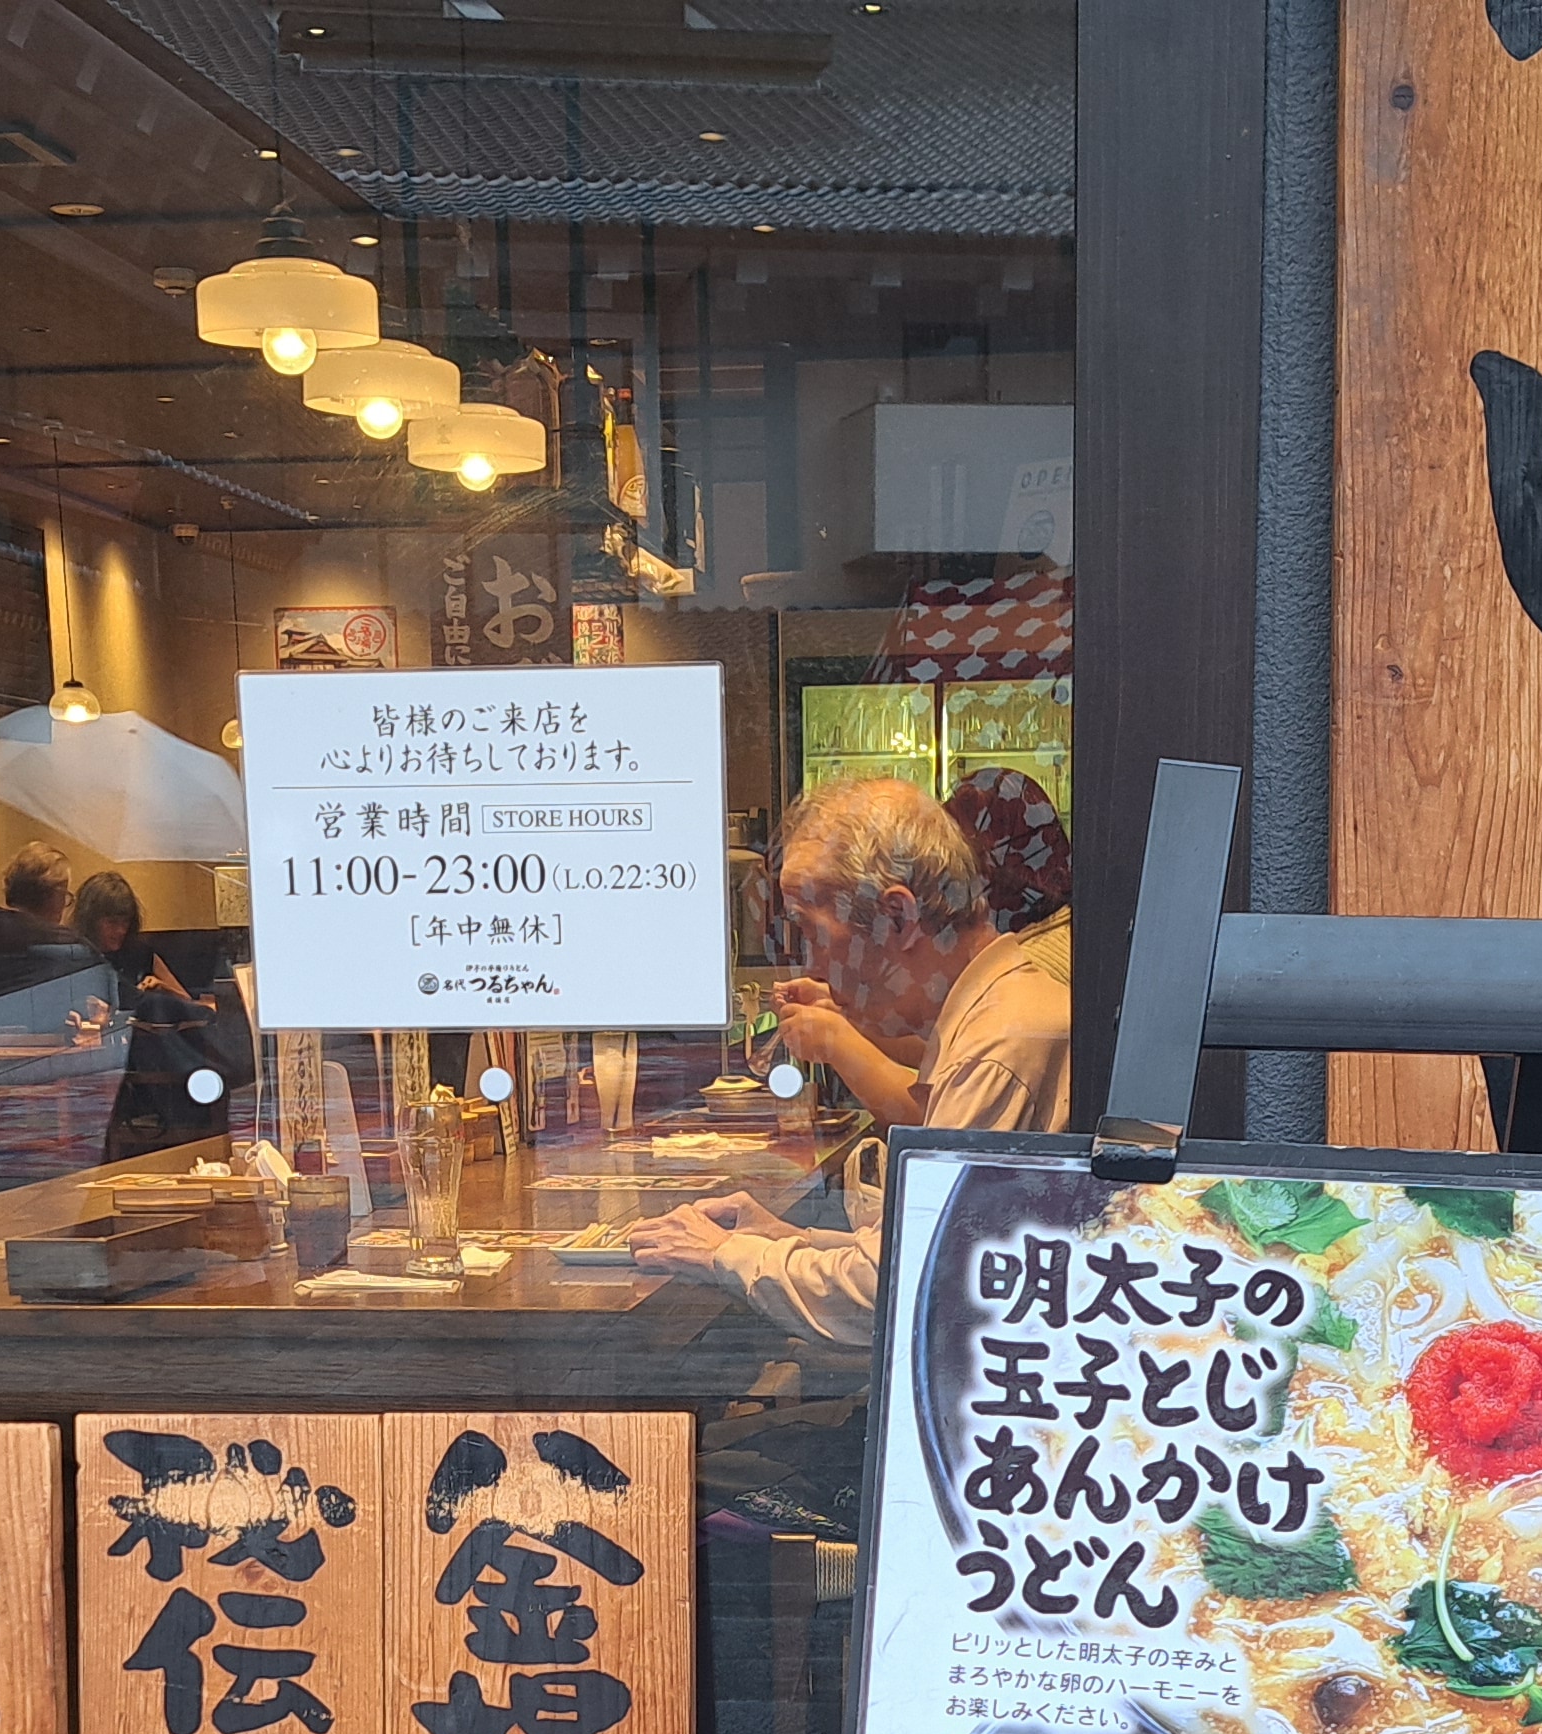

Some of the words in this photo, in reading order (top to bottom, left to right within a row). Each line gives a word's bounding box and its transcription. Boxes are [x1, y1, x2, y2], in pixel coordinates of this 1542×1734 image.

[372, 702, 589, 739] 皆様のご来店を
[320, 740, 640, 775] 心よりお待ちしております。
[314, 802, 471, 839] 営業時間
[492, 809, 563, 830] STORE
[568, 807, 644, 828] HOURS
[979, 1233, 1304, 1328] 明太子の
[971, 1333, 1277, 1432] 玉子とじ
[964, 1426, 1325, 1533] あんかけ
[956, 1519, 1180, 1629] うどん
[951, 1632, 1239, 1674] ピリッとした明太子の辛みと
[948, 1665, 1242, 1707] まろやかな卵のハーモニーを
[945, 1697, 1130, 1731] お楽しみください。
